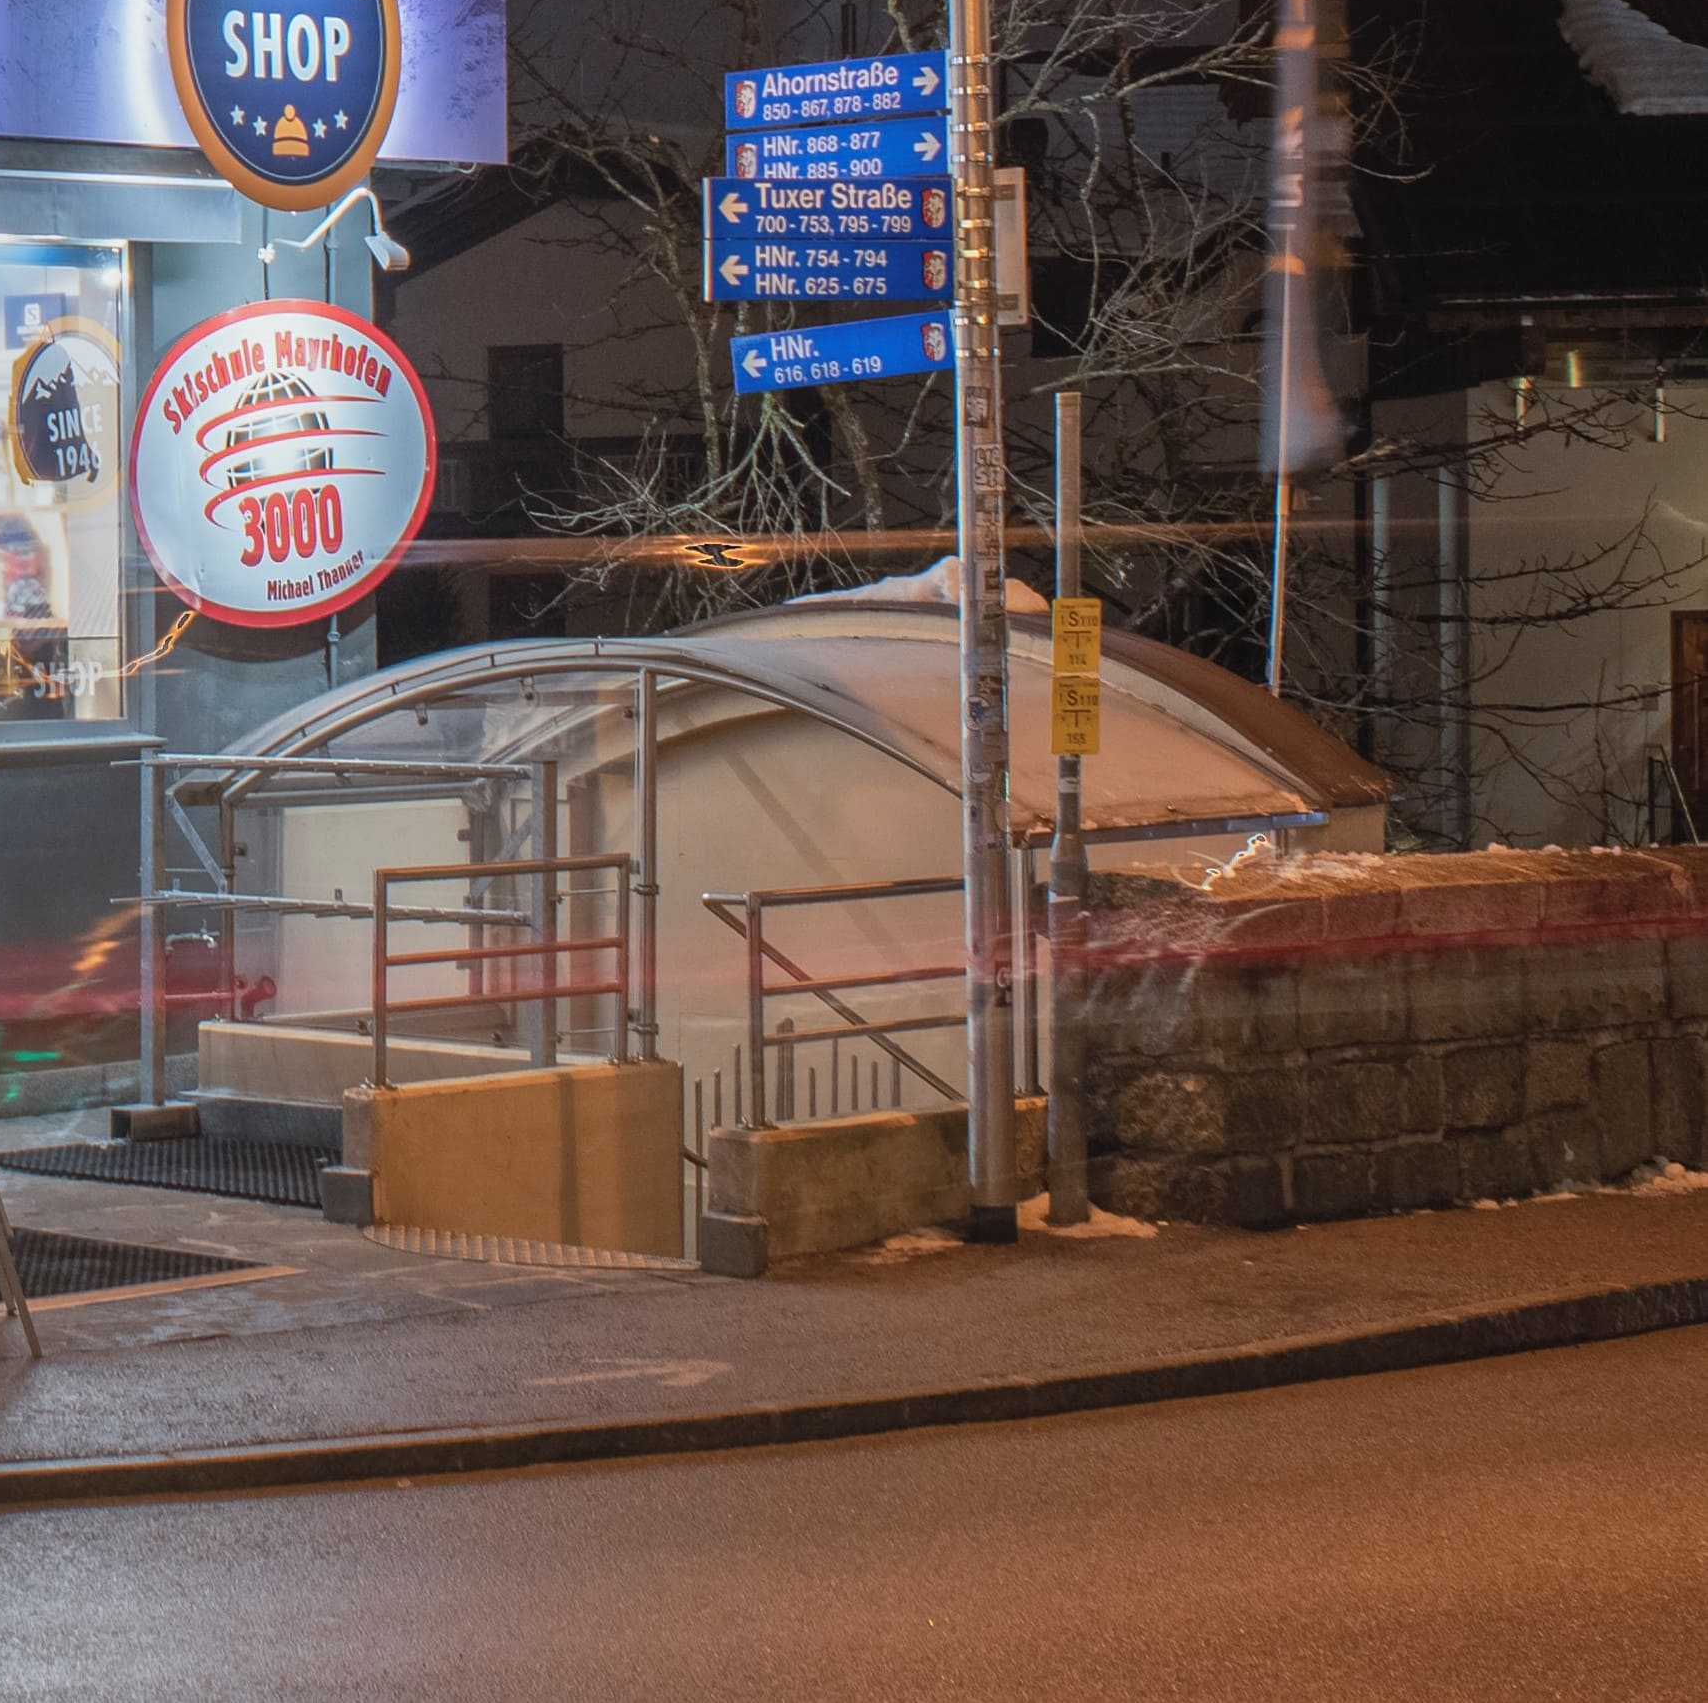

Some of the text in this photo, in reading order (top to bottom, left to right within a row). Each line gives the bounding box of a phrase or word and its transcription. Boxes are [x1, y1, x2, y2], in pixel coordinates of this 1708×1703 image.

[223, 8, 351, 83] SHOP
[762, 62, 899, 97] Ahornstraße
[763, 102, 791, 121] 850
[833, 95, 862, 115] 878
[872, 91, 902, 111] 882
[763, 135, 804, 157] HNr.
[806, 135, 839, 155] 868
[849, 131, 881, 151] 877
[806, 161, 839, 179] 885
[849, 157, 883, 177] 900
[754, 182, 913, 209] Tuxer Straße
[755, 215, 787, 233] 700
[837, 215, 870, 233] 795
[880, 215, 913, 234] 799
[754, 244, 802, 267] HNr.
[805, 249, 841, 268] 754
[853, 249, 888, 268] 794
[754, 272, 802, 295] HNr.
[804, 277, 840, 295] 625
[852, 277, 888, 295] 675
[770, 334, 820, 362] HNr.
[810, 360, 841, 379] 618
[851, 355, 882, 375] 619
[163, 330, 392, 435] Skischule Mayrhofen
[46, 403, 104, 444] SINCE
[54, 442, 103, 477] 1946
[238, 484, 344, 568] 3000
[267, 549, 366, 601] Michael Thanner
[32, 659, 103, 698] SHOP
